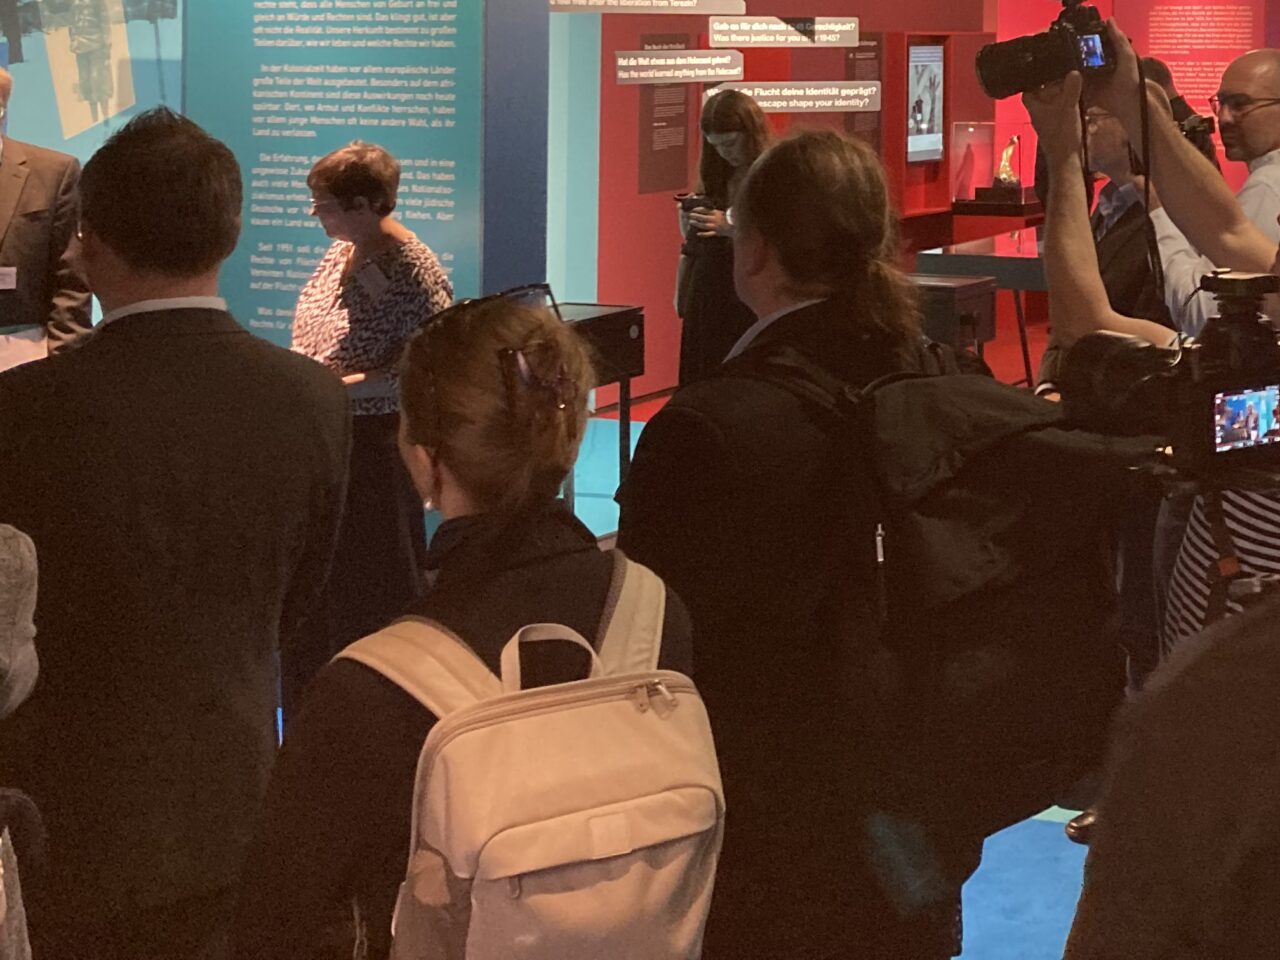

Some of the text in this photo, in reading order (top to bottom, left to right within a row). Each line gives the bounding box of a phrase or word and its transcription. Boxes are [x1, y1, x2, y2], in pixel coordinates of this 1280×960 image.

[753, 86, 877, 96] Flucht deine Identität geprägt?
[758, 98, 869, 108] escape shape your identity?
